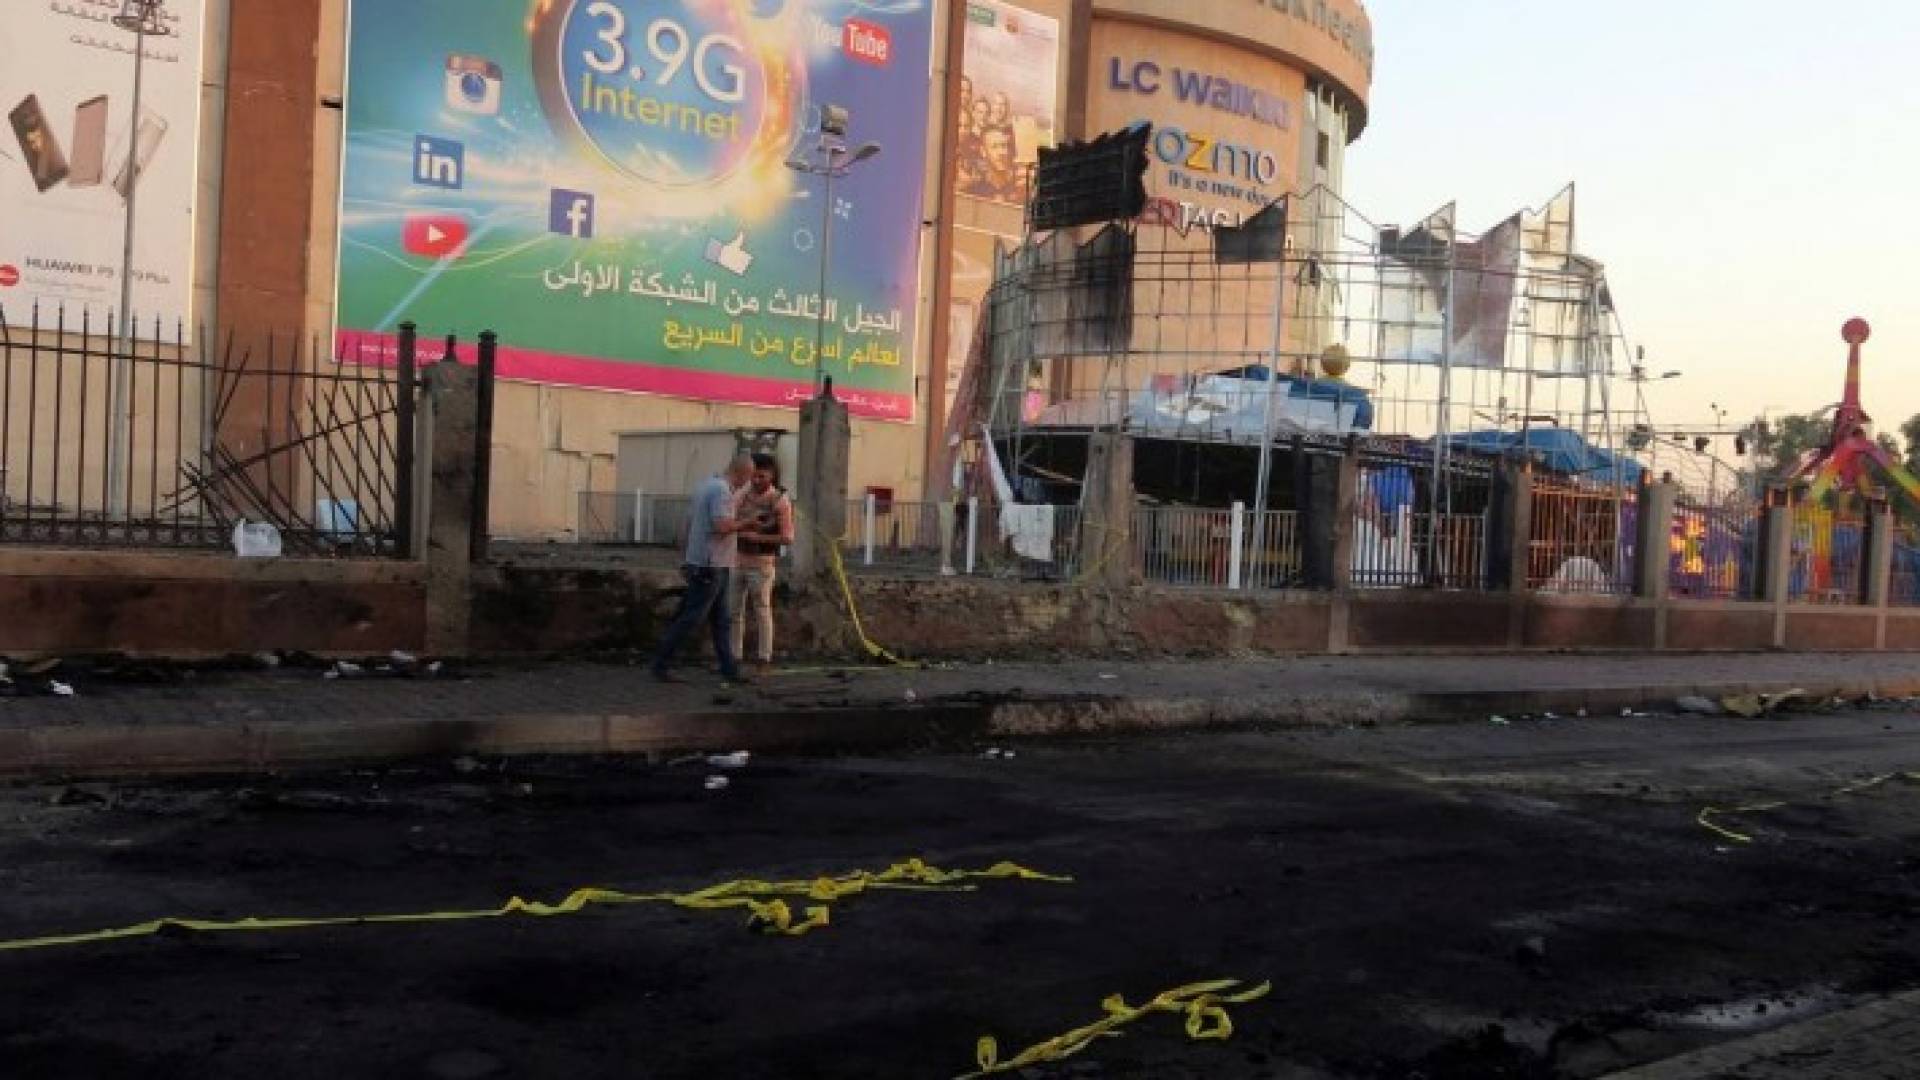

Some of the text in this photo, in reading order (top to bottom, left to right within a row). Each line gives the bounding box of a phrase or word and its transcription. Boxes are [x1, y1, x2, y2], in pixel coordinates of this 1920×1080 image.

[583, 2, 746, 101] 3.9G
[1109, 56, 1161, 95] LC
[581, 72, 744, 143] Internet
[420, 142, 457, 184] in
[1130, 119, 1277, 184] ozmo
[25, 256, 93, 274] HUAWEI
[628, 269, 717, 306] الشبكة
[723, 288, 760, 316] من
[768, 288, 838, 323] الثالث
[663, 319, 743, 350] السريع
[844, 303, 901, 336] الجيل
[751, 331, 784, 356] من
